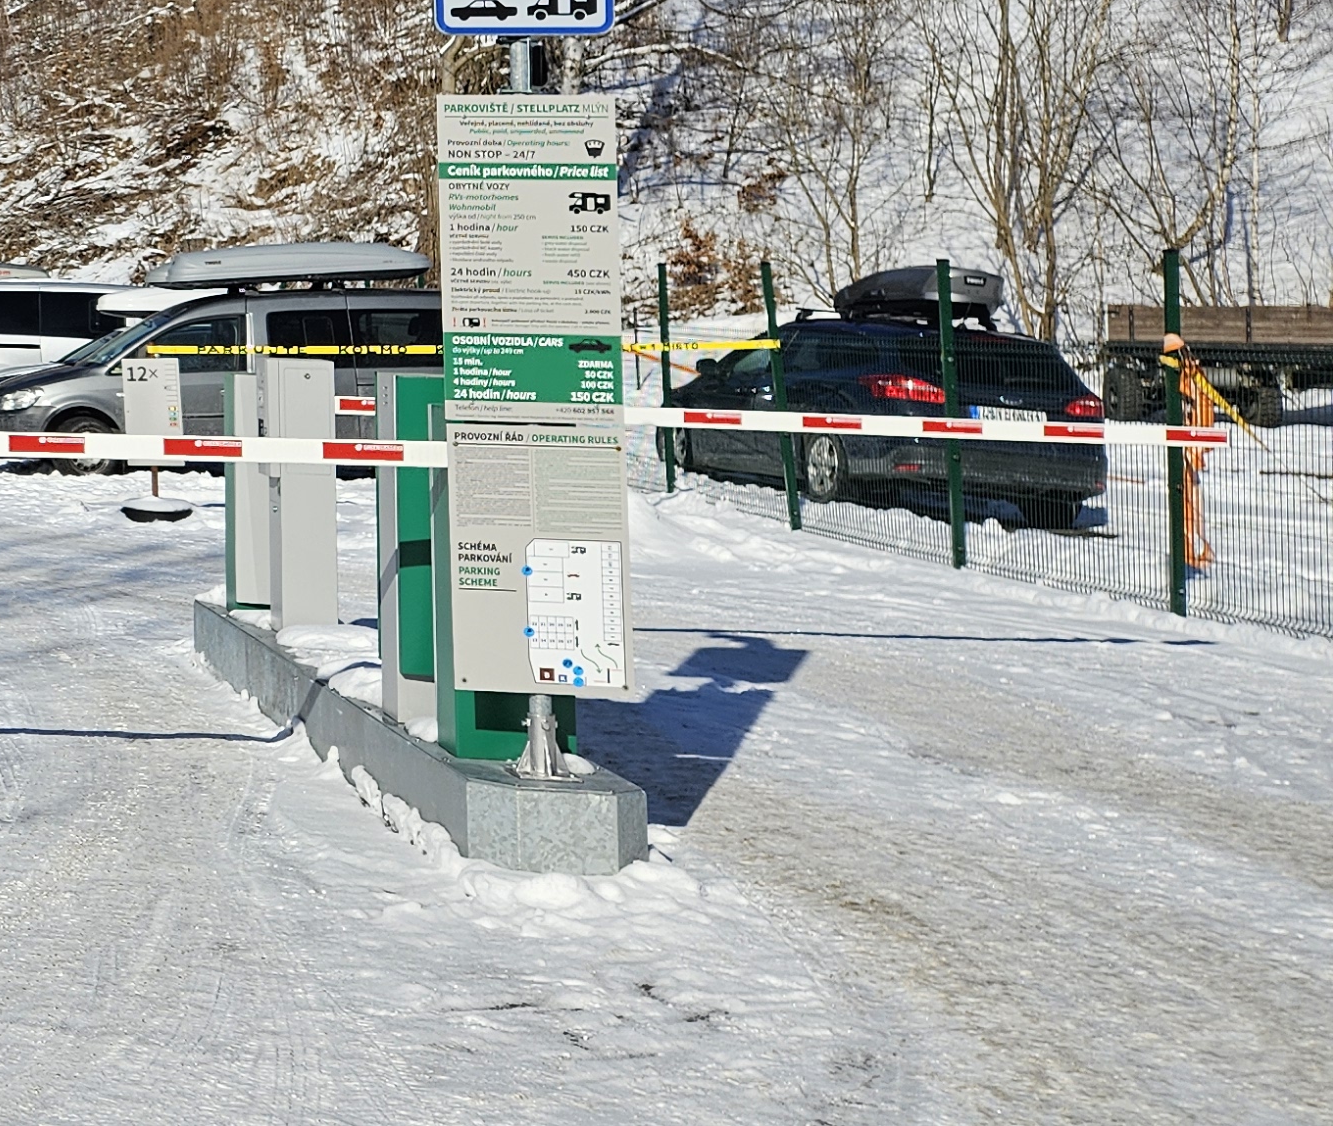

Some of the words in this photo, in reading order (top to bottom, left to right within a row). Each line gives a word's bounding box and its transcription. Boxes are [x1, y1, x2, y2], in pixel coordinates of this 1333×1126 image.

[444, 103, 508, 113] PARKOVIŠTĚ
[517, 104, 580, 113] STELLPLATZ
[583, 102, 609, 113] MLÝN
[447, 138, 482, 146] Provozní
[475, 151, 502, 159] STOP
[513, 151, 536, 160] 24/7
[448, 164, 481, 176] Ceník
[590, 166, 609, 177] list
[449, 181, 484, 190] OBYTNÉ
[571, 225, 587, 233] 150
[590, 225, 609, 233] CZK
[451, 268, 463, 276] 24
[466, 267, 496, 277] hodin
[503, 268, 532, 277] hours
[567, 270, 587, 278] 450
[589, 270, 610, 279] CZK
[452, 334, 491, 346] OSOBNÍ
[339, 345, 407, 355] KOLMO
[464, 358, 483, 366] min.
[578, 360, 614, 369] ZDARMA
[585, 371, 596, 379] 50
[597, 371, 614, 379] CZK
[453, 378, 459, 386] 4
[581, 381, 596, 389] 100
[597, 381, 614, 389] CZK
[454, 389, 468, 399] 24
[469, 388, 500, 399] hodin
[506, 389, 537, 400] hours
[571, 392, 591, 402] 150
[593, 392, 615, 403] CZK
[454, 431, 503, 441] PROVOZNÍ
[505, 431, 524, 442] ŘÁD
[532, 434, 586, 444] OPERATING
[588, 436, 619, 444] RULES
[458, 540, 497, 552] SCHÉMA
[458, 552, 513, 564] PARKOVÁNÍ
[459, 567, 501, 576] PARKING
[459, 578, 498, 587] SCHEME
